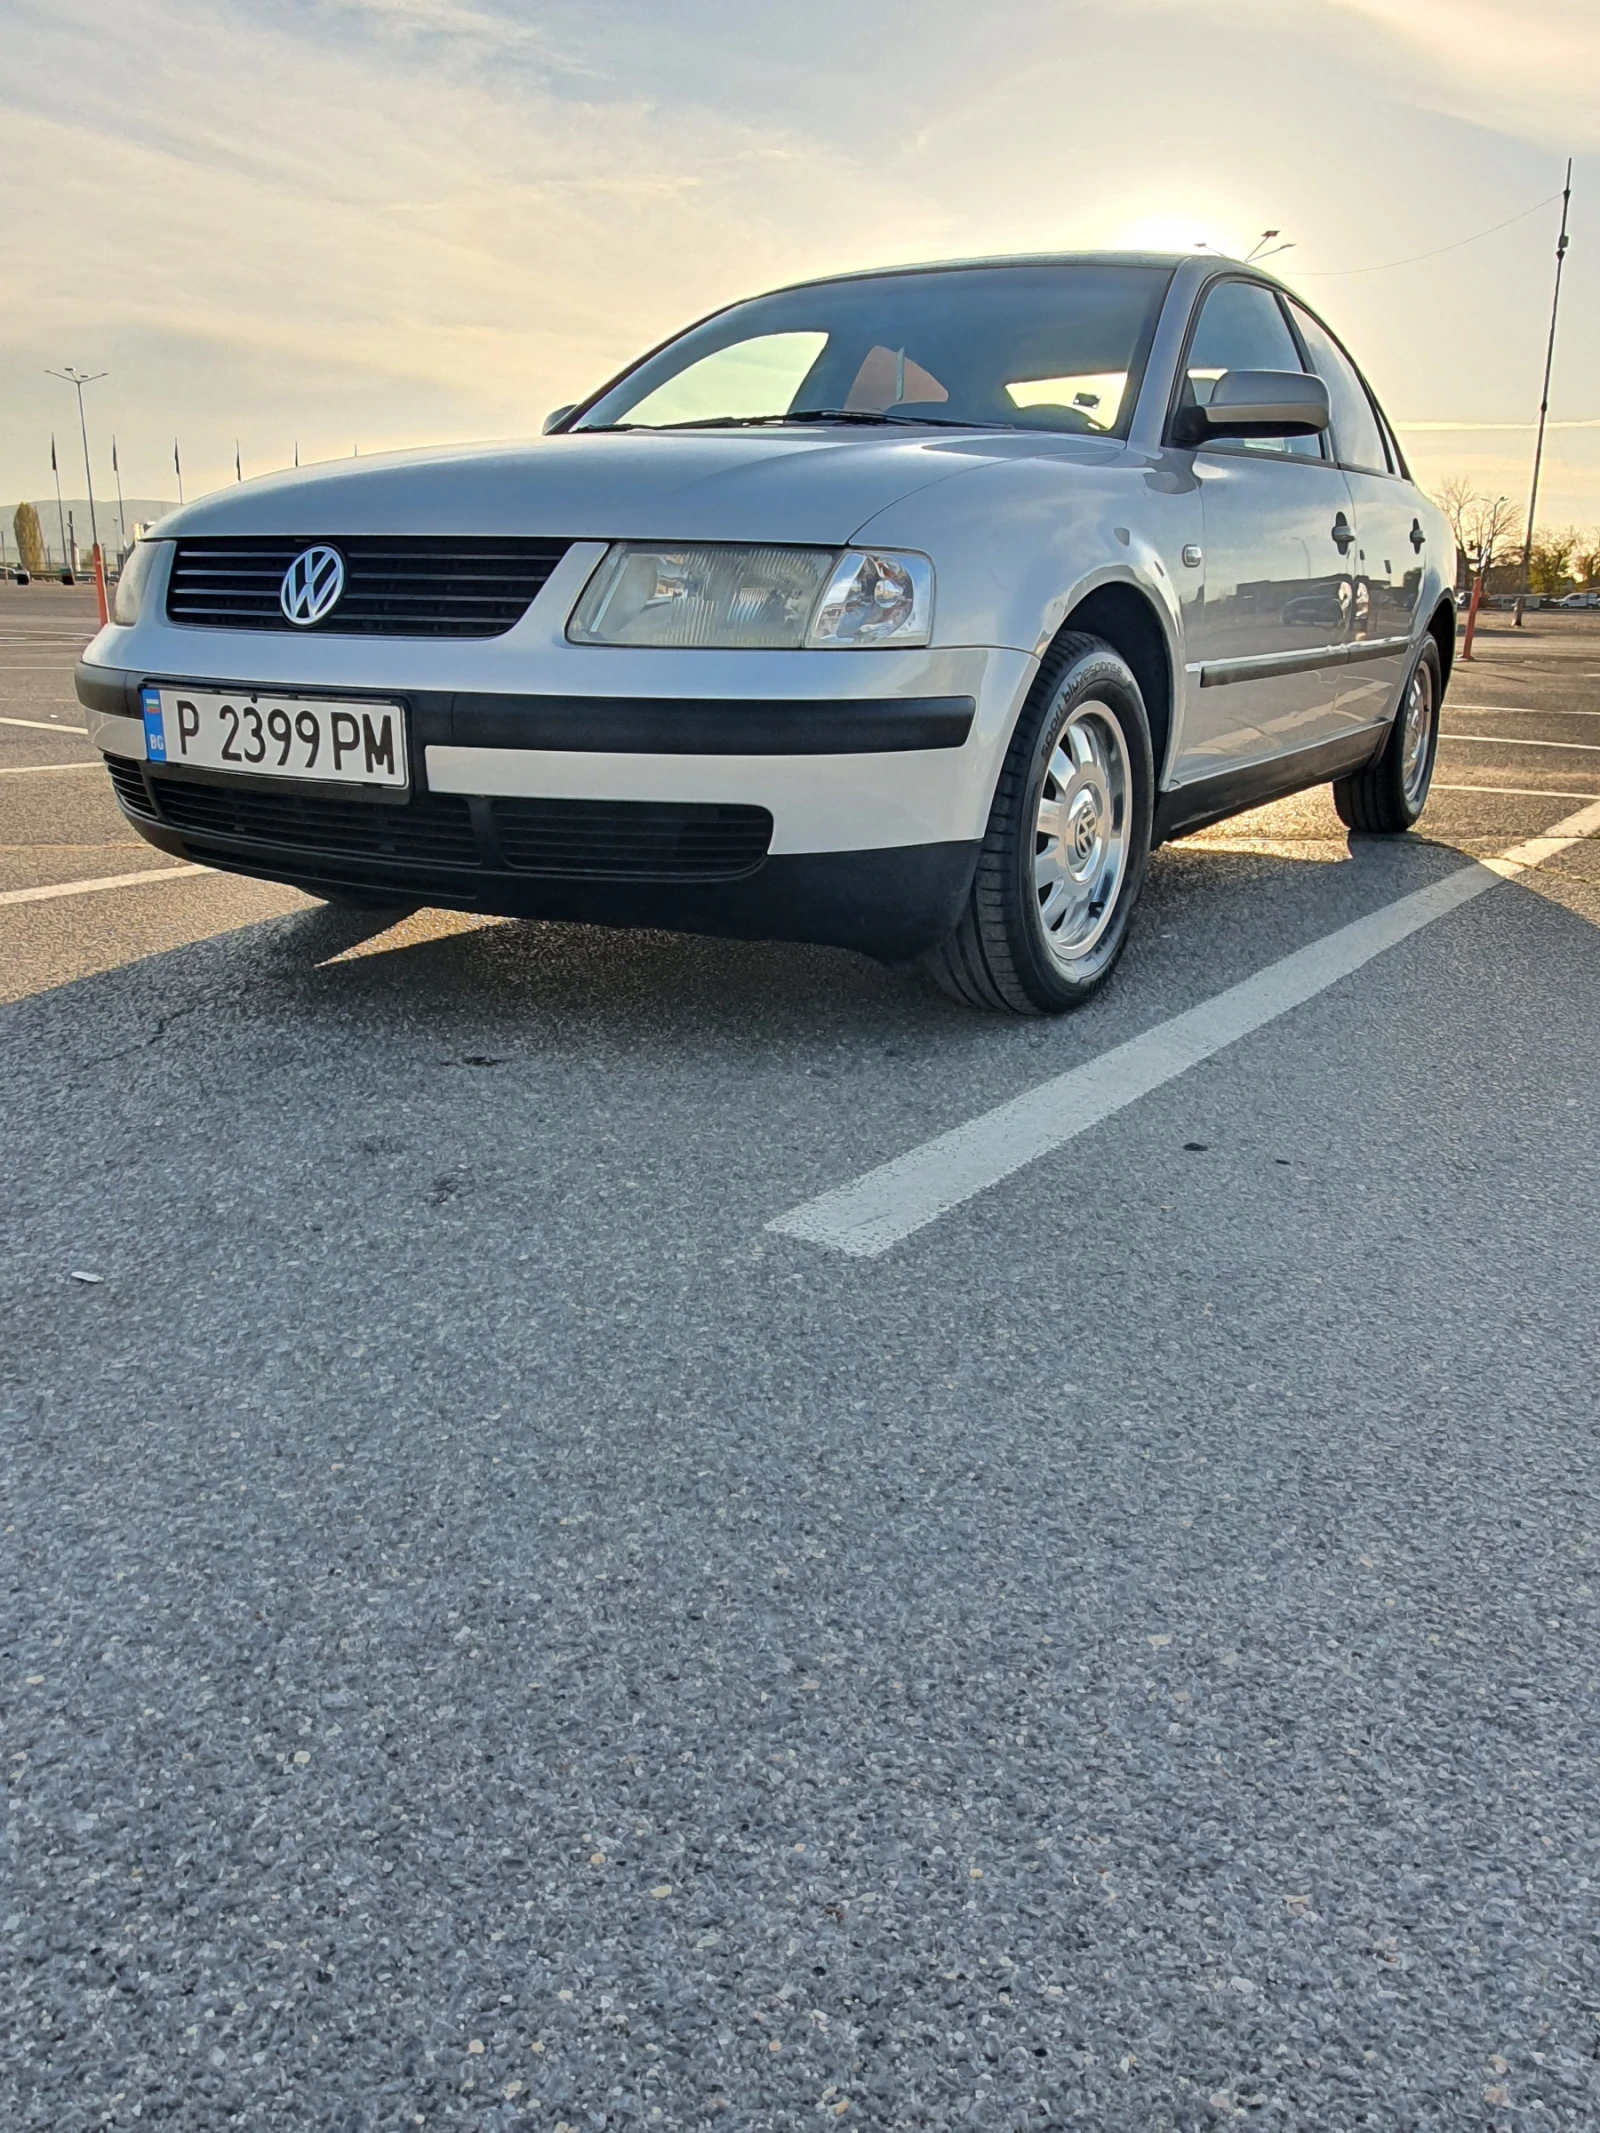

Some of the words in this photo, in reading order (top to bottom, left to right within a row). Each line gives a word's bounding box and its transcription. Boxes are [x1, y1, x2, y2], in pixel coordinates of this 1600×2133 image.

[282, 546, 343, 624] VW
[150, 733, 165, 751] BG
[176, 700, 200, 755] P
[218, 704, 320, 768] 2399
[330, 711, 395, 775] PM
